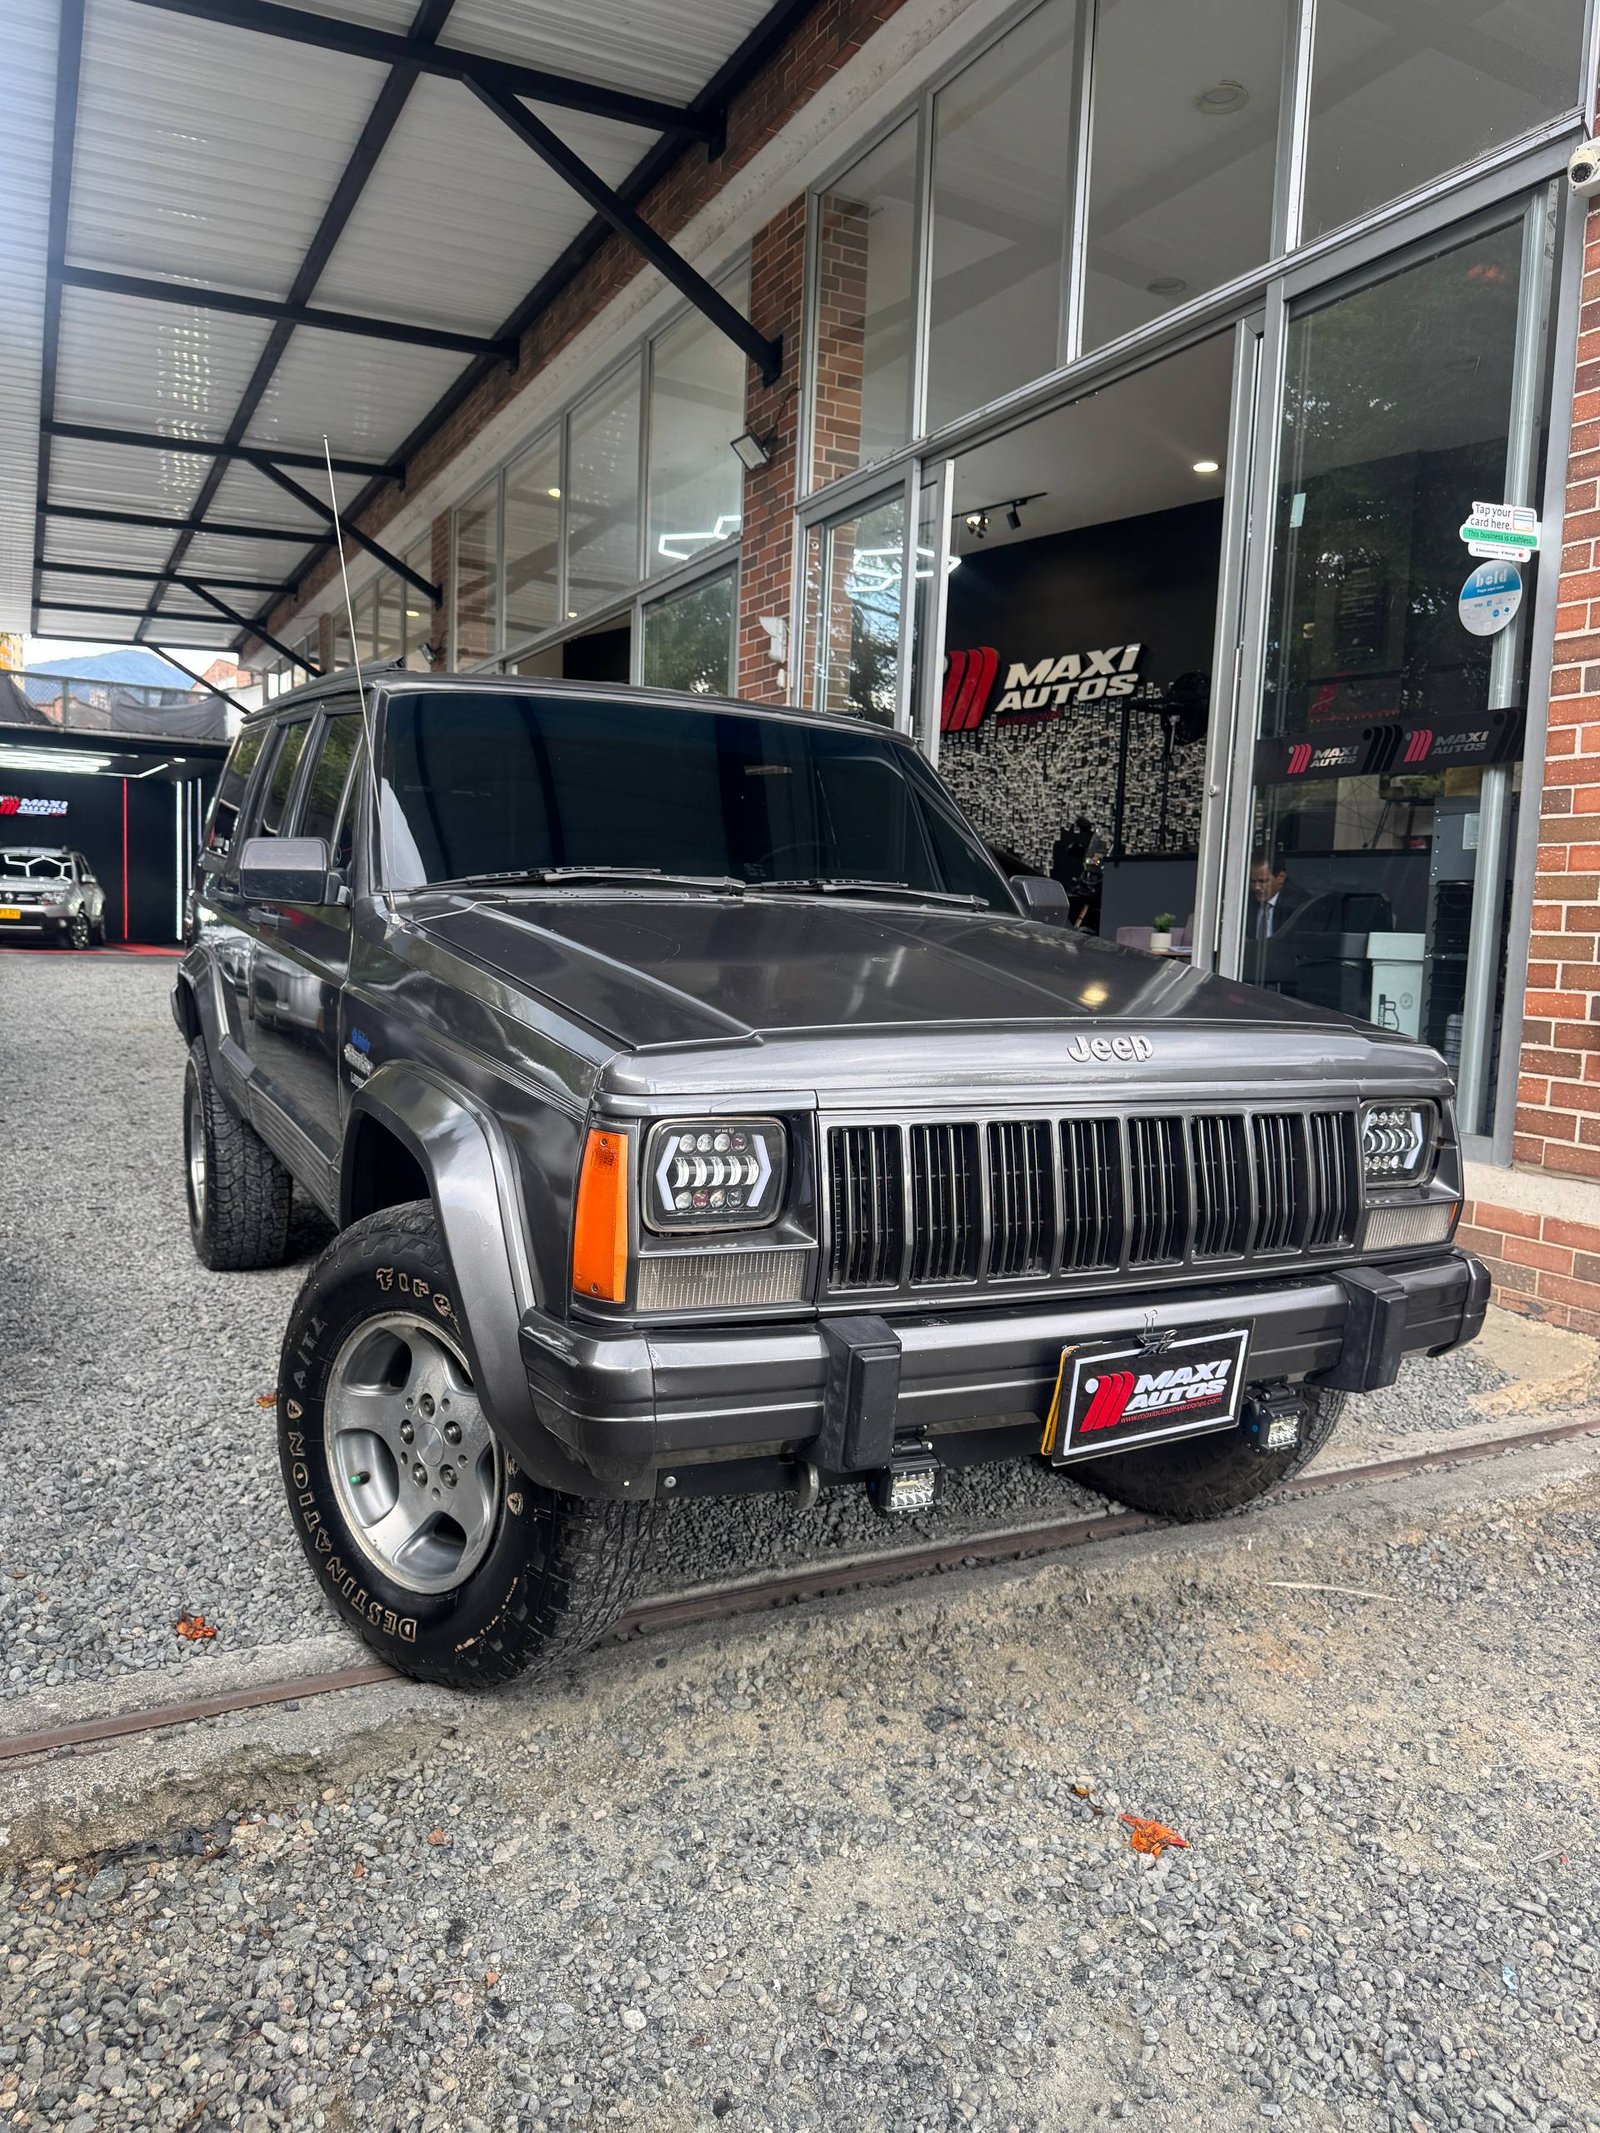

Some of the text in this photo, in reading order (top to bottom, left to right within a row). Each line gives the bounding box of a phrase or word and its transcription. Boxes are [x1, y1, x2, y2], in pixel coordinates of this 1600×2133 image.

[1475, 504, 1511, 518] Tap your
[1470, 517, 1512, 530] card here.
[1468, 529, 1479, 538] This
[1480, 531, 1504, 540] business
[1476, 569, 1508, 588] bold
[1003, 643, 1142, 690] MAXI
[994, 673, 1139, 712] AUTOS
[1434, 730, 1490, 746] MAXI
[1313, 745, 1360, 759] MAXI
[1432, 742, 1487, 755] AUTOS
[1310, 755, 1357, 768] AUTOS
[20, 798, 69, 808] MAXI
[1066, 1035, 1154, 1062] Jeep
[1133, 1359, 1232, 1394] MAXI
[1125, 1378, 1228, 1411] AUTOS
[288, 1431, 417, 1643] DESTINATION
